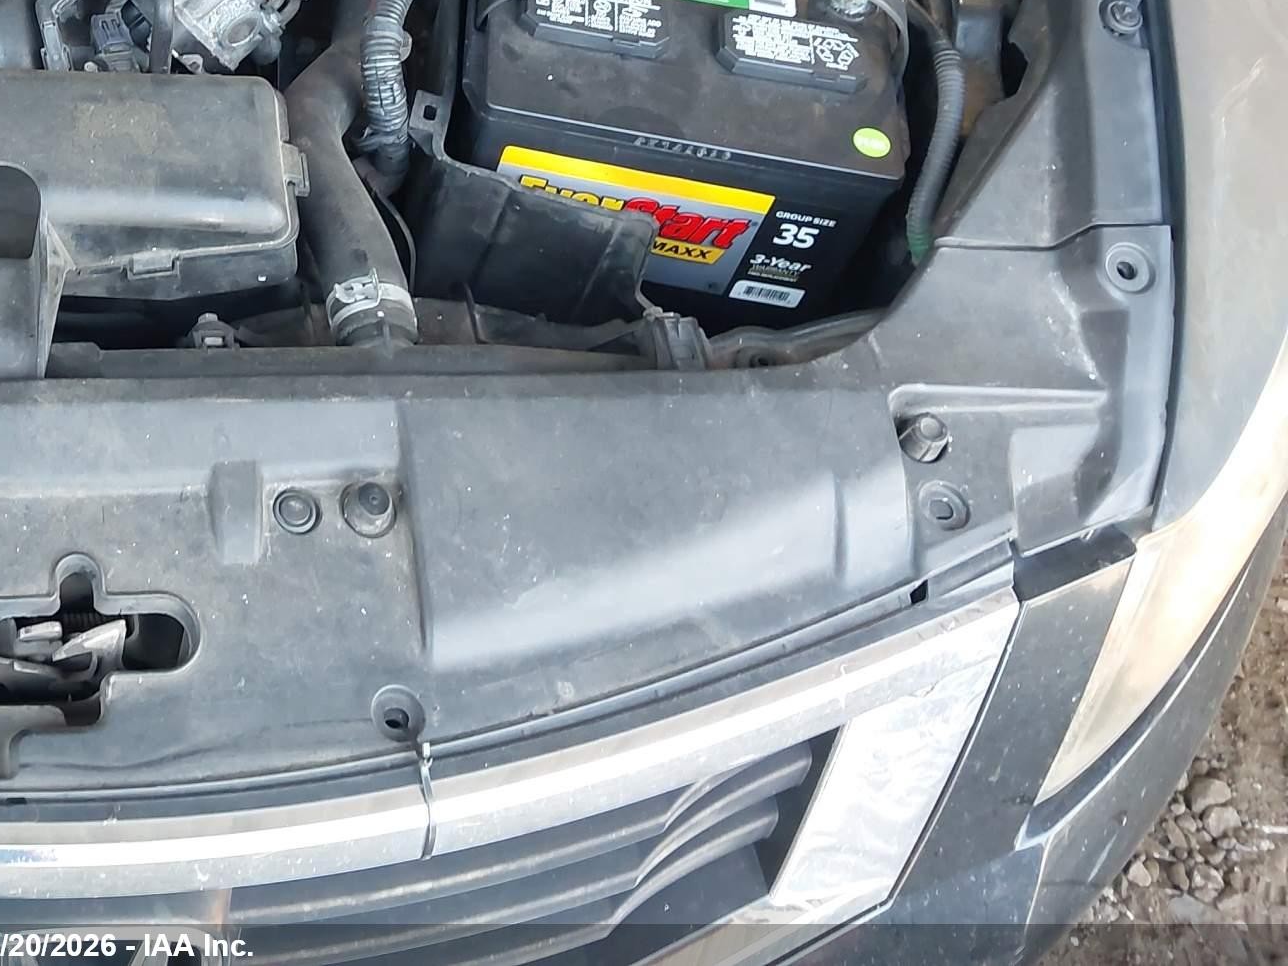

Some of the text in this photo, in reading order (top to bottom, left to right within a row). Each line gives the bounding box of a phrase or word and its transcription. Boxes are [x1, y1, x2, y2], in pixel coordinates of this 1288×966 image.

[775, 210, 837, 228] GROUP SIZE
[772, 223, 820, 249] 35
[749, 253, 812, 272] 3-Year
